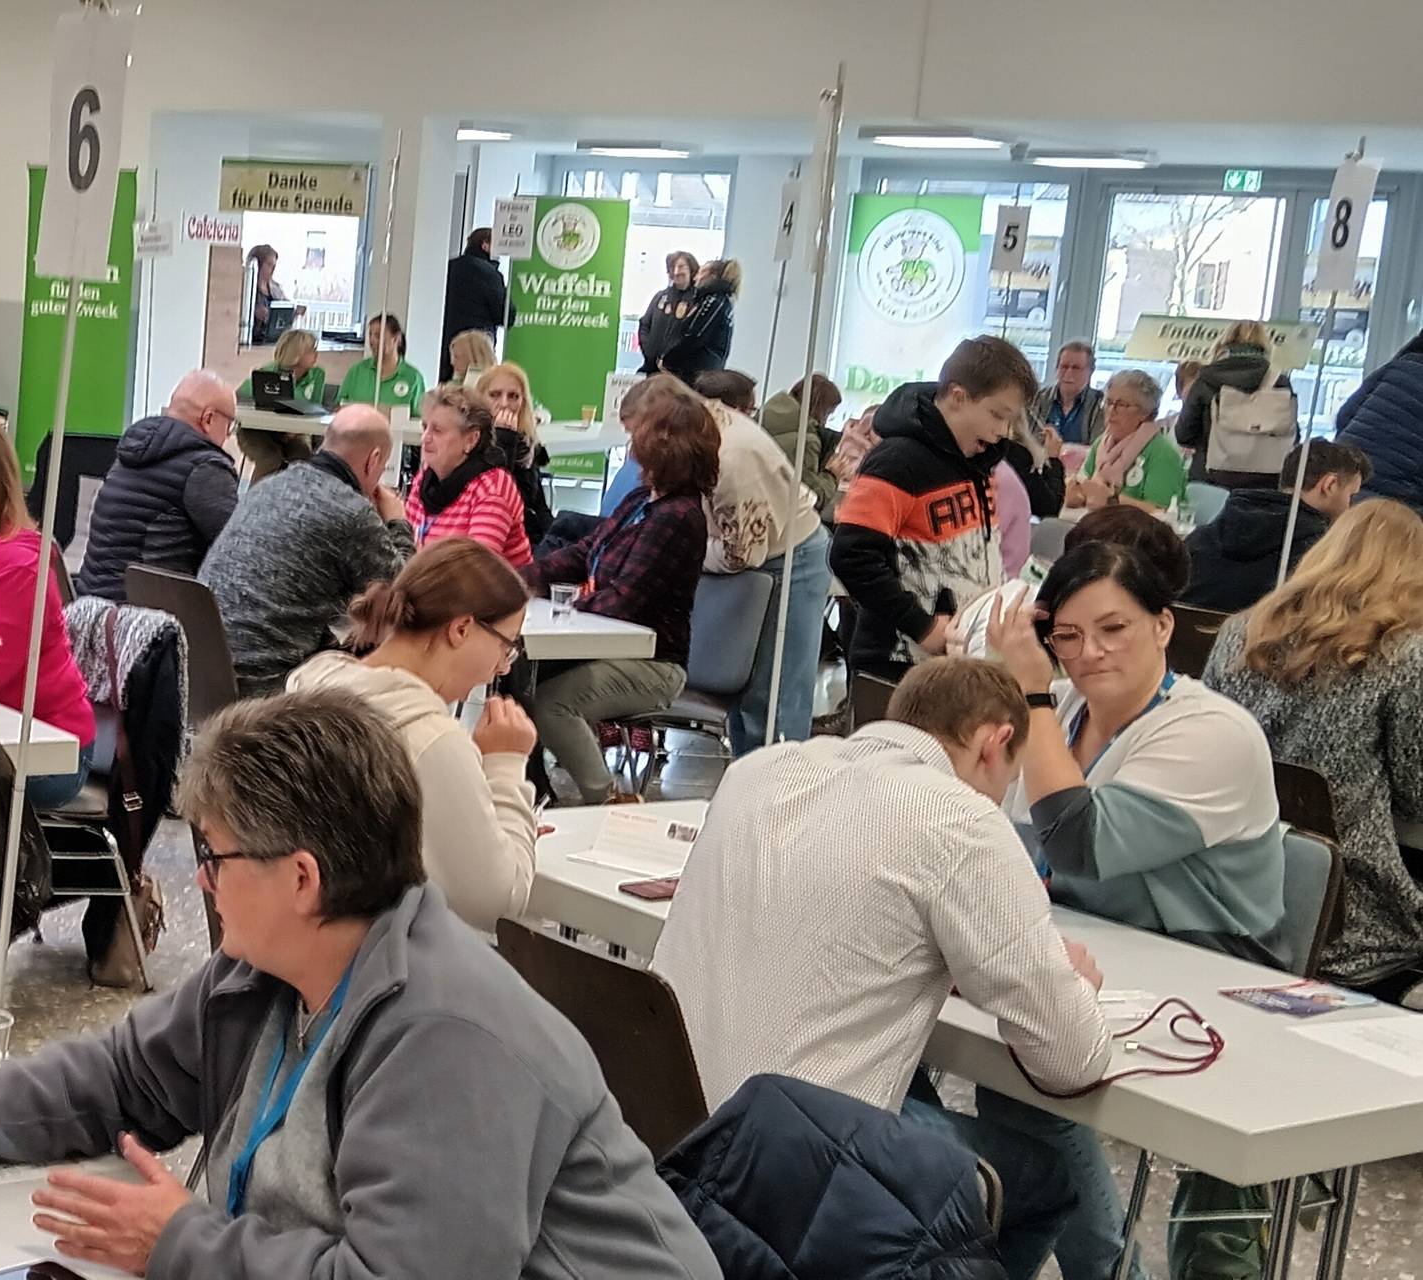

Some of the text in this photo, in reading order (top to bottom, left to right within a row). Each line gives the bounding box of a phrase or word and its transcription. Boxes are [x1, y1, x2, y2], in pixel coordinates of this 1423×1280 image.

[68, 85, 101, 193] 6
[267, 170, 318, 192] Danke
[231, 188, 353, 213] für Ihre Spende
[187, 214, 239, 242] Cafeteria
[502, 223, 524, 238] LEO
[782, 200, 795, 236] 4
[1331, 197, 1353, 250] 8
[1003, 223, 1019, 252] 5
[517, 272, 612, 297] Waffeln
[536, 295, 590, 313] für den
[513, 311, 610, 329] guten Zweck
